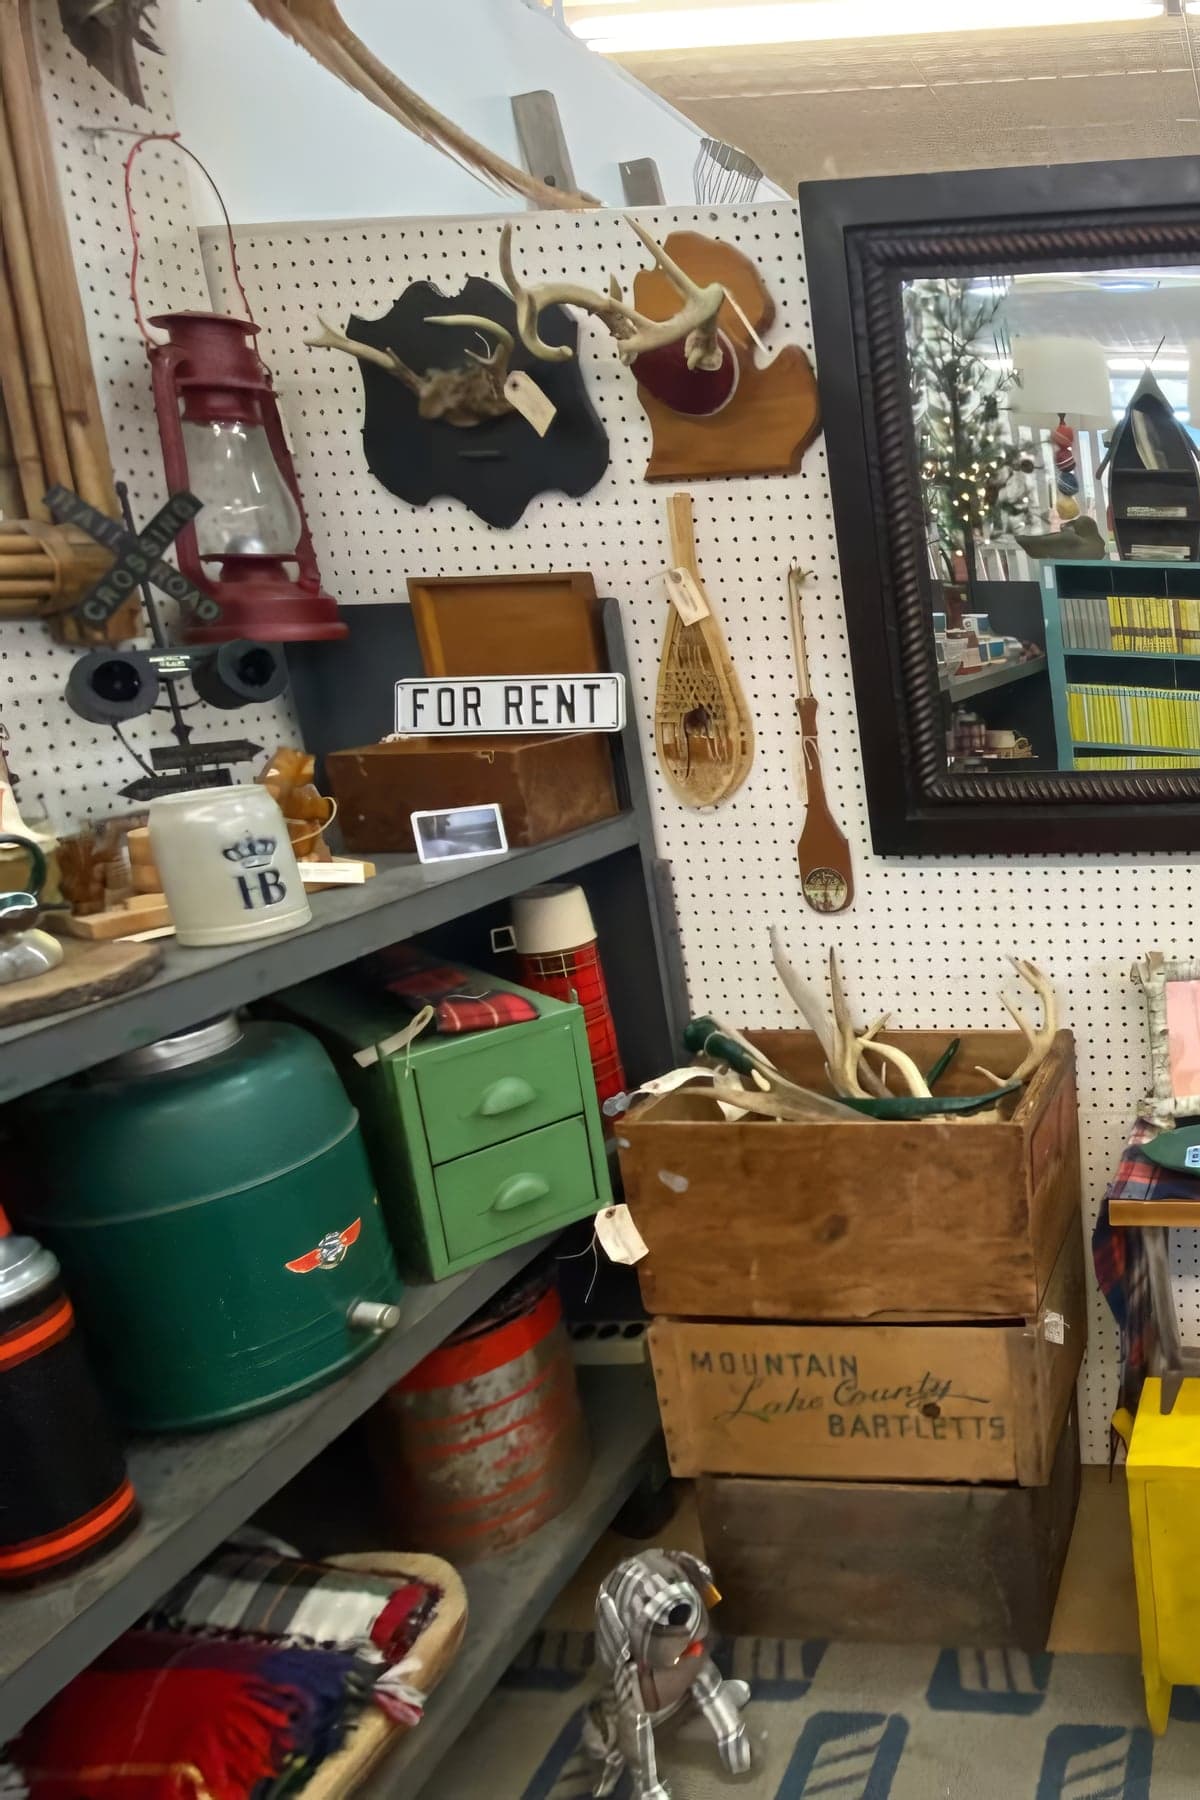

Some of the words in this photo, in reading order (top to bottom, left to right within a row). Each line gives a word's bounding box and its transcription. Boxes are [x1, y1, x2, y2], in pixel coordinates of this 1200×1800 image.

[82, 498, 198, 621] CROSSING
[412, 685, 482, 728] FOR
[504, 683, 601, 726] RENT
[235, 868, 288, 910] HB
[690, 1351, 858, 1381] MOUNTAIN
[711, 1377, 824, 1424] Lake
[832, 1371, 992, 1409] County
[828, 1413, 1006, 1441] BARTLETTS
